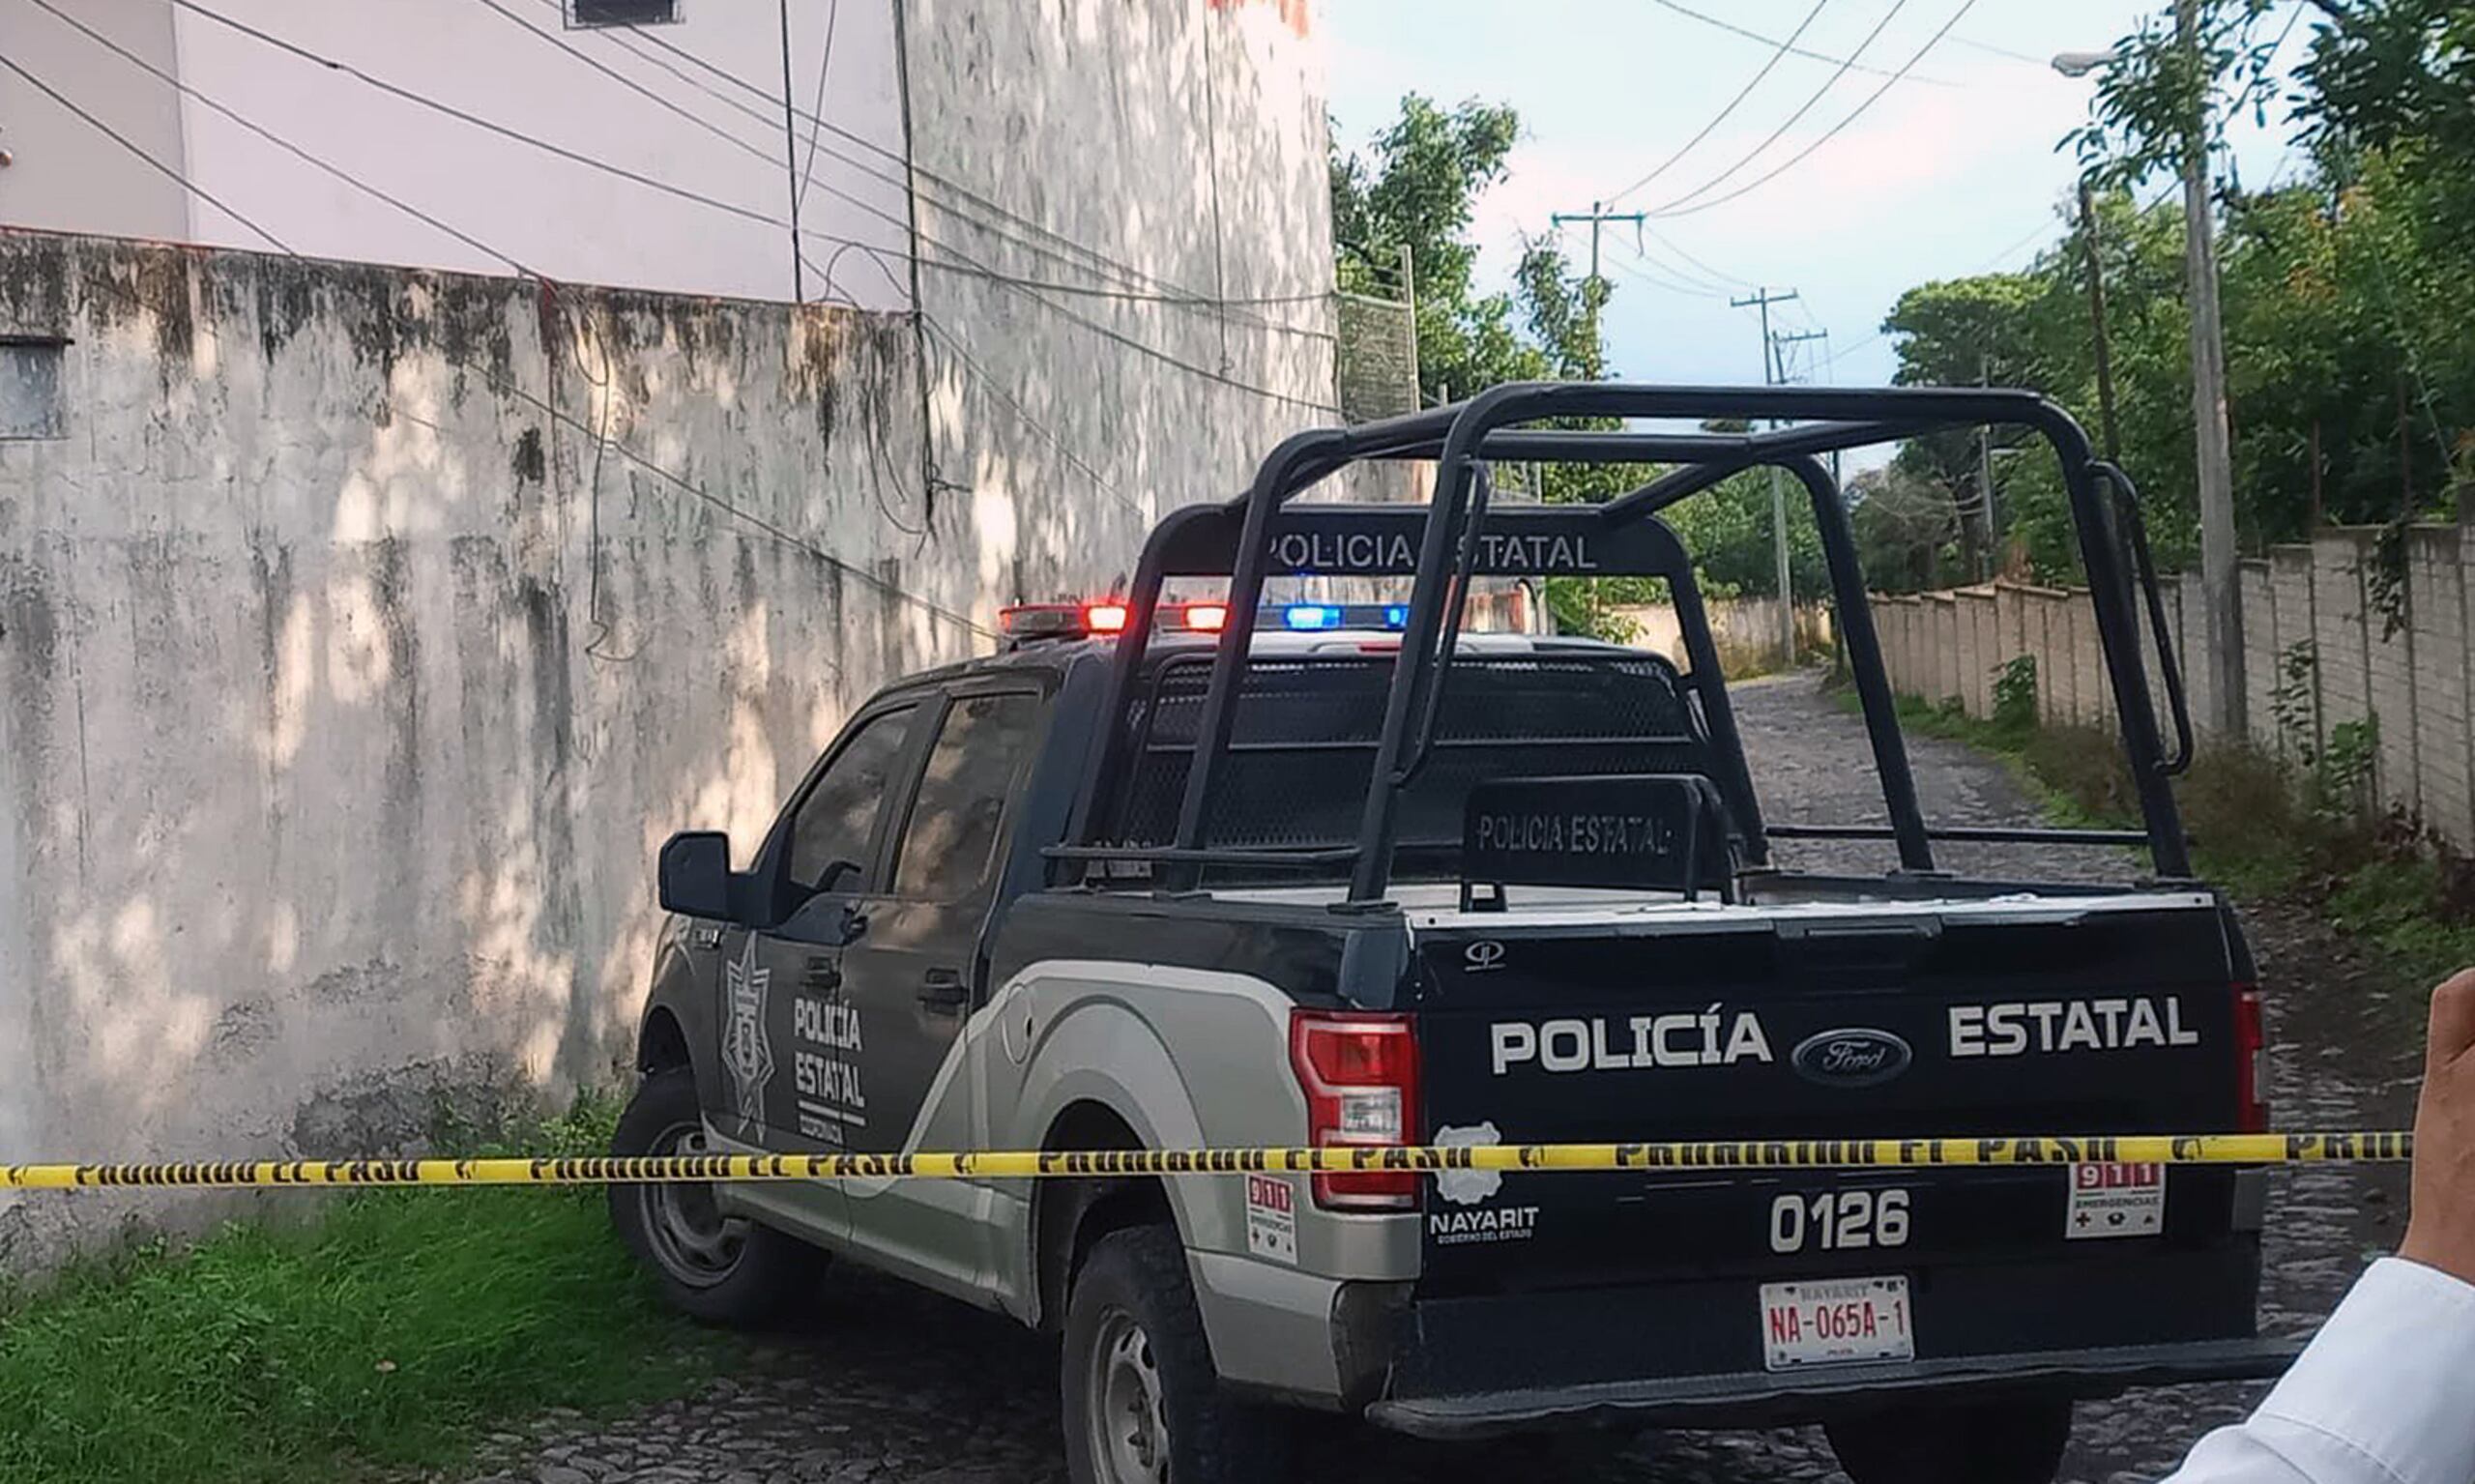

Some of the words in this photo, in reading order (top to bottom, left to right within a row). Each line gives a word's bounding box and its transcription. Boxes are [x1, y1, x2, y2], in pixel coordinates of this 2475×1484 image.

[1456, 536, 1597, 568] STATAL
[1478, 814, 1563, 851] POLICIA
[1570, 815, 1671, 855] ESTATAL
[794, 998, 862, 1052] POLICÍA
[1490, 1002, 1774, 1075] POLICÍA
[1948, 996, 2199, 1058] ESTATAL
[1822, 1039, 1885, 1071] Ford
[795, 1052, 865, 1108] ESTATAL
[2081, 1163, 2152, 1187] 911
[1430, 1207, 1540, 1235] NAYARIT
[1770, 1188, 1910, 1253] 0126
[1769, 1299, 1904, 1345] NA-065A-1
